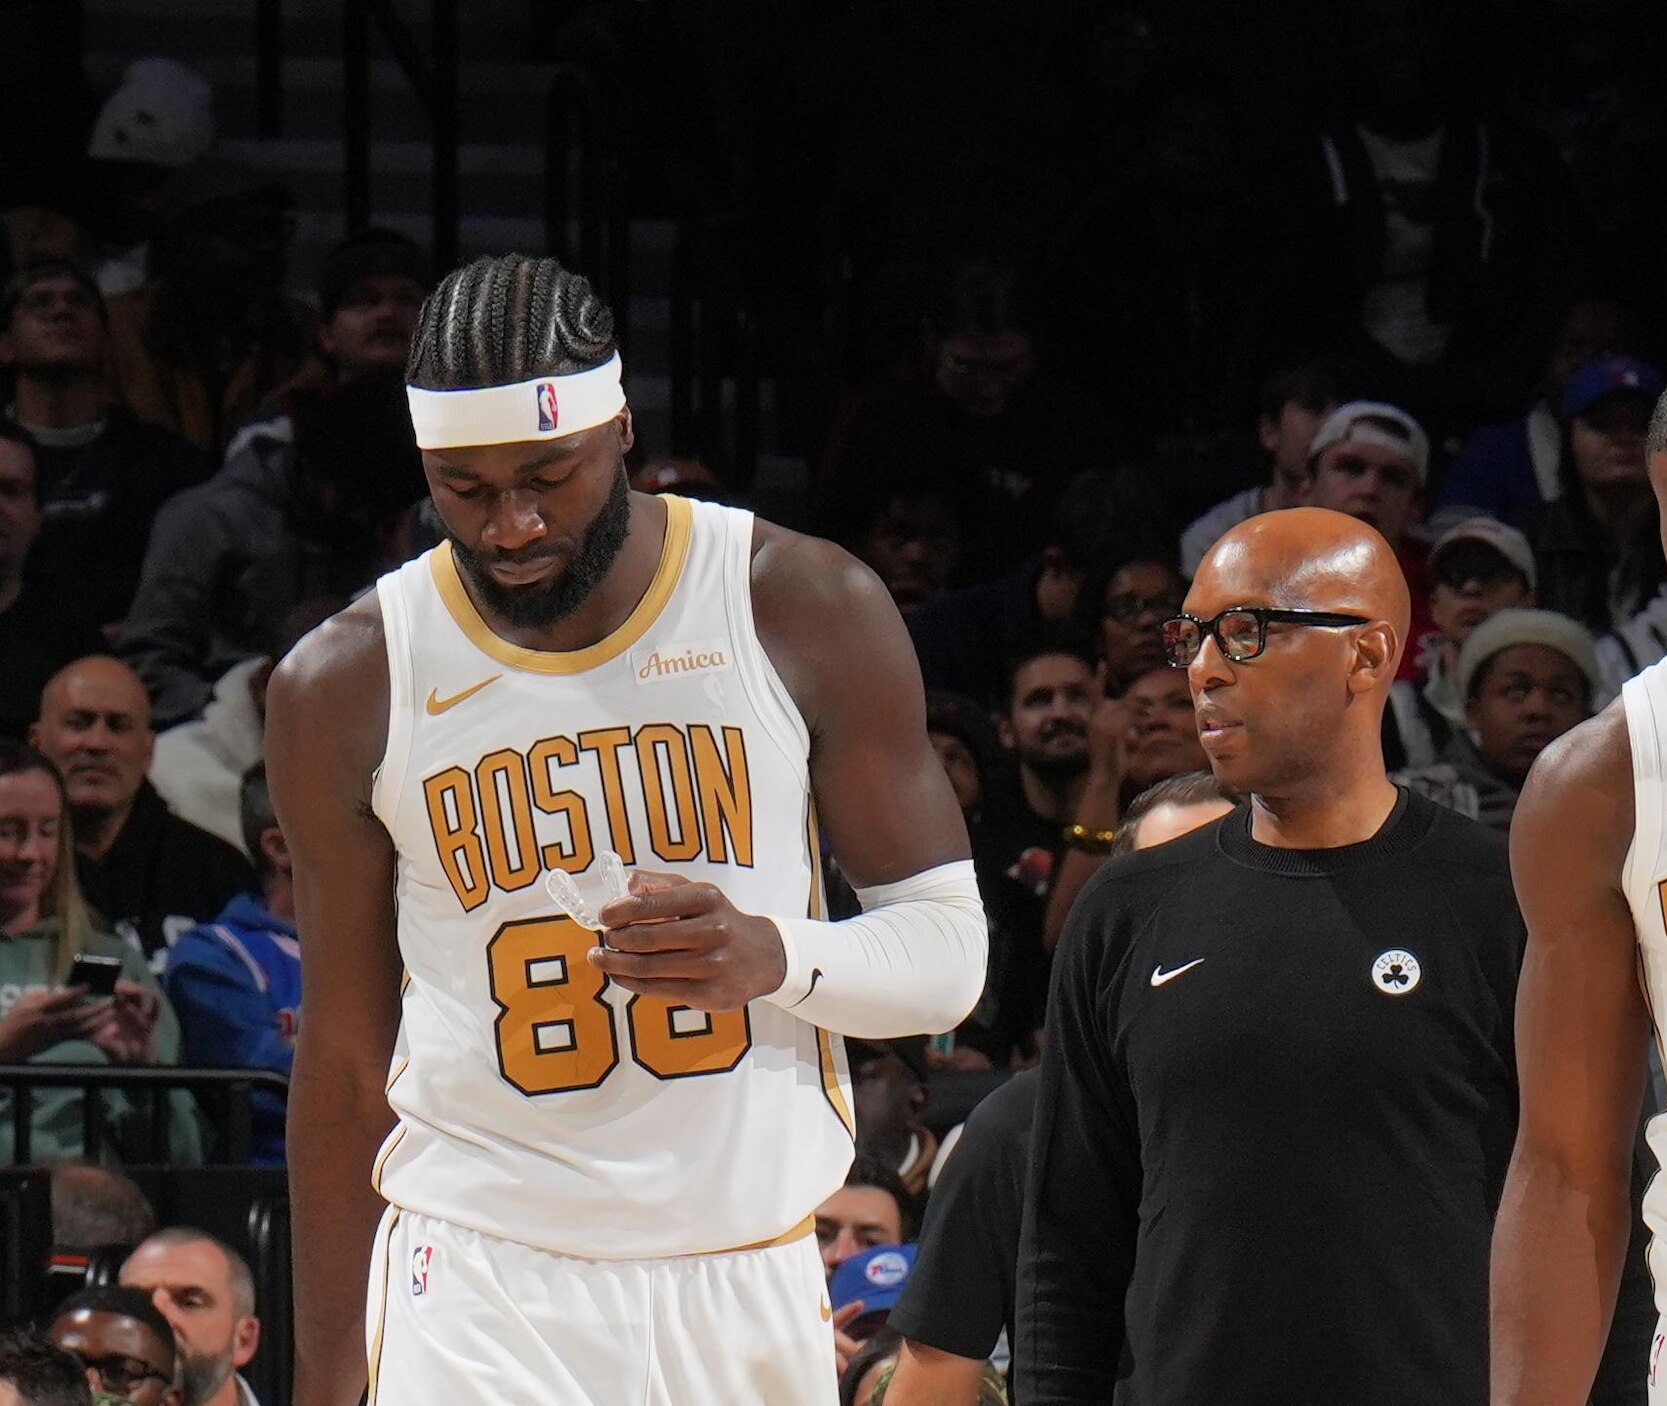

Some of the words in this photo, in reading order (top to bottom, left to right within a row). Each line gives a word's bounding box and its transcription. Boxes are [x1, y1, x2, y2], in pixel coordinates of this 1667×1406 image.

[639, 650, 727, 679] Amica
[423, 723, 754, 913] BOSTON
[1376, 953, 1418, 972] CELTICS
